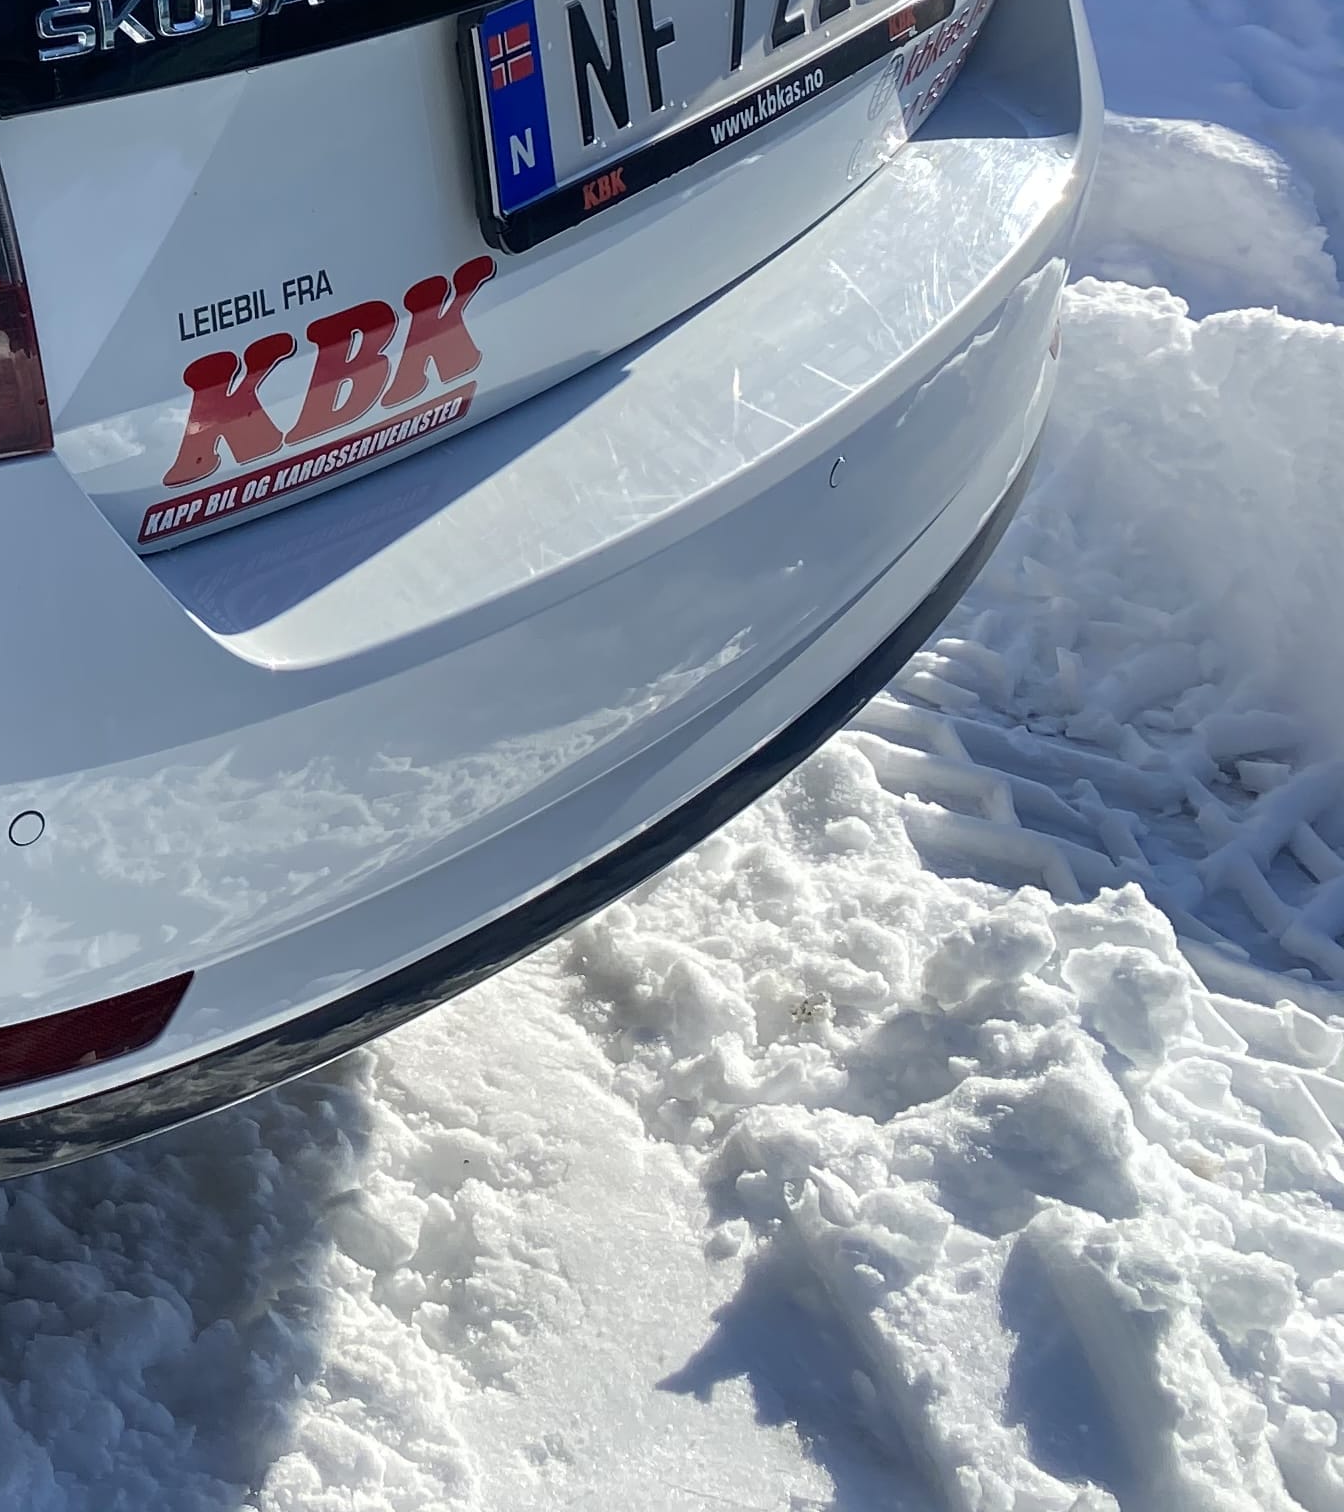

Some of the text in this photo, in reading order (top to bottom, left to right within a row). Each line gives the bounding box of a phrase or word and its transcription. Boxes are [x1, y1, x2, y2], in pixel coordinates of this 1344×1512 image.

[509, 127, 536, 176] N
[583, 166, 628, 211] KBK
[710, 67, 825, 145] www.kbkas.no
[162, 254, 497, 489] KBK
[177, 268, 334, 342] LEIEBIL FRA
[143, 396, 463, 537] KAPP BIL OG KAROSSERIVERKSTED
